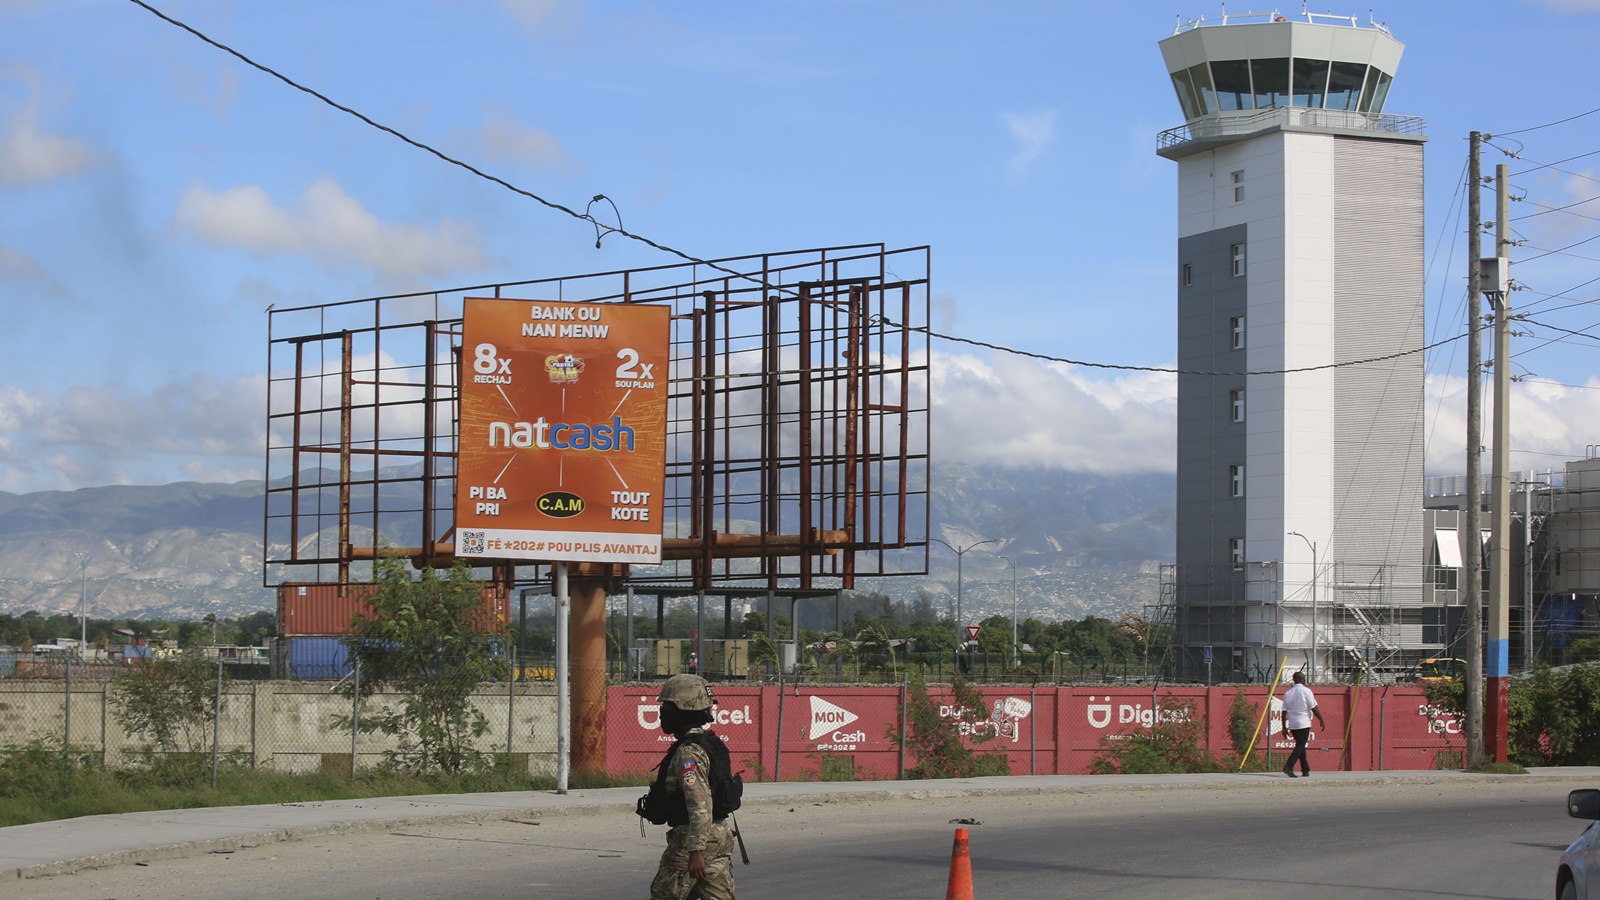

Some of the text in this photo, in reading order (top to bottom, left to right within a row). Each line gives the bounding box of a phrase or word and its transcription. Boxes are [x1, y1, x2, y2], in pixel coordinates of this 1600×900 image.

[531, 305, 601, 321] BANK OU
[522, 323, 609, 339] NAN MENW
[474, 375, 512, 385] RECHAJ
[615, 380, 654, 389] SOU PLAN
[489, 416, 635, 451] natcash
[470, 486, 507, 500] PI BA
[611, 490, 650, 505] TOUT
[476, 502, 499, 515] PRI
[539, 498, 582, 511] C.A.M
[611, 507, 649, 521] KOTE
[487, 538, 502, 550] FÈ
[547, 542, 572, 553] POU
[574, 543, 601, 553] PLIS
[602, 543, 658, 555] AVANTAJ
[814, 711, 845, 723] MON
[832, 730, 866, 743] Cash
